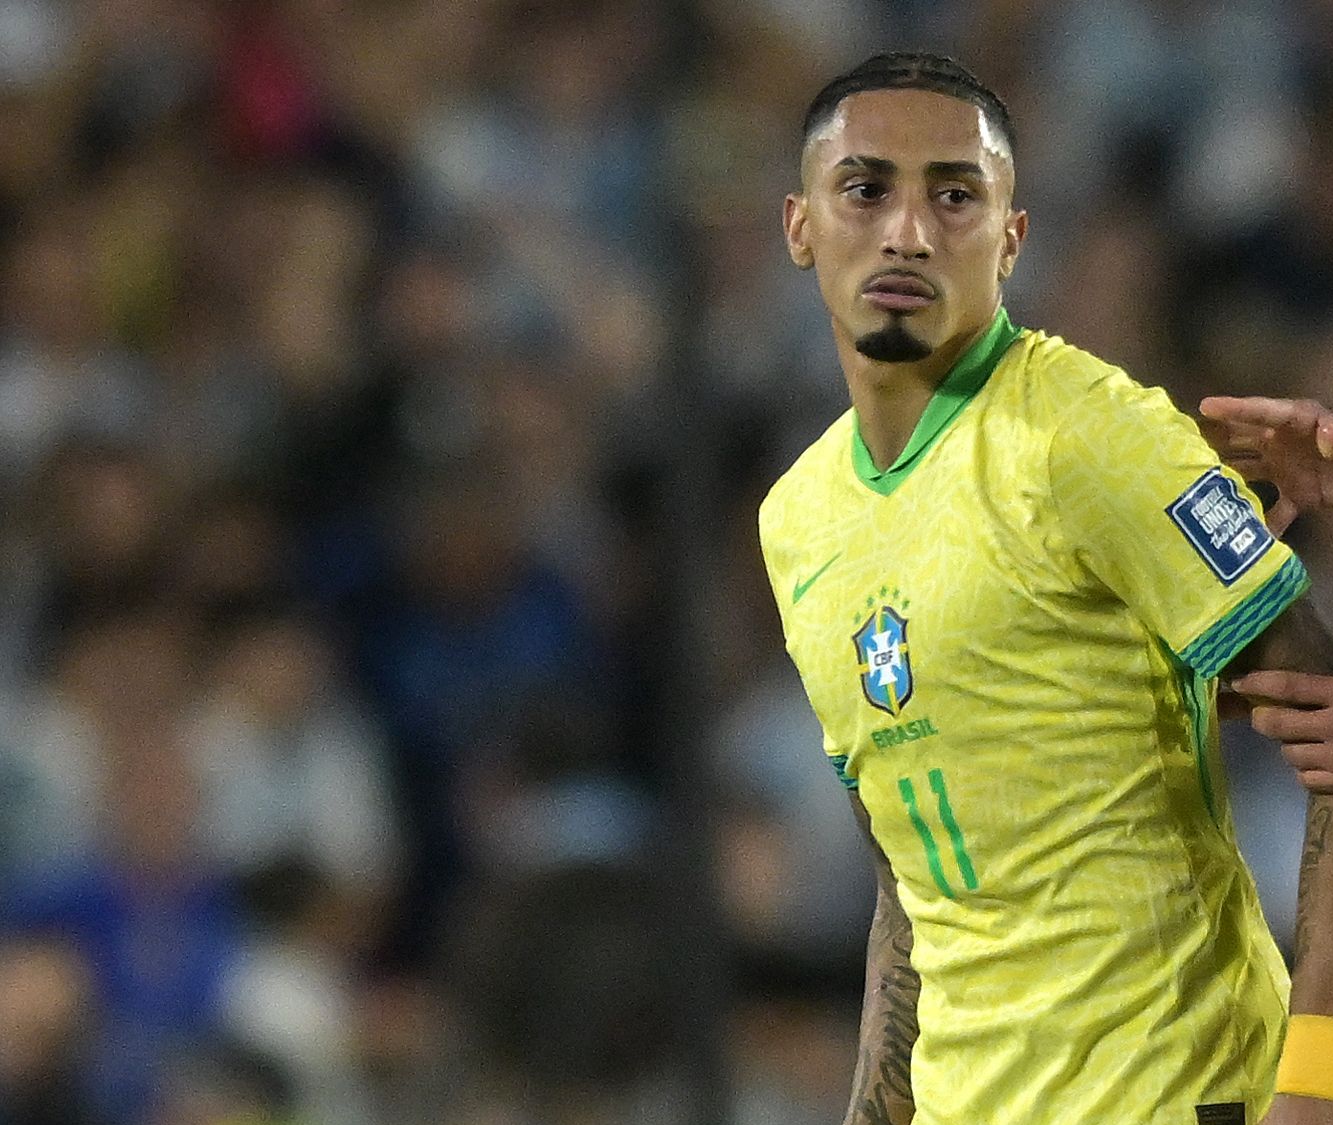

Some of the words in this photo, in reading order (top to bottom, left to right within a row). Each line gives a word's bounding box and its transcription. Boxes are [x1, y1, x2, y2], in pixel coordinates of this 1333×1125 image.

[873, 650, 894, 668] CBF
[870, 717, 939, 750] BRASIL
[897, 767, 980, 900] 11
